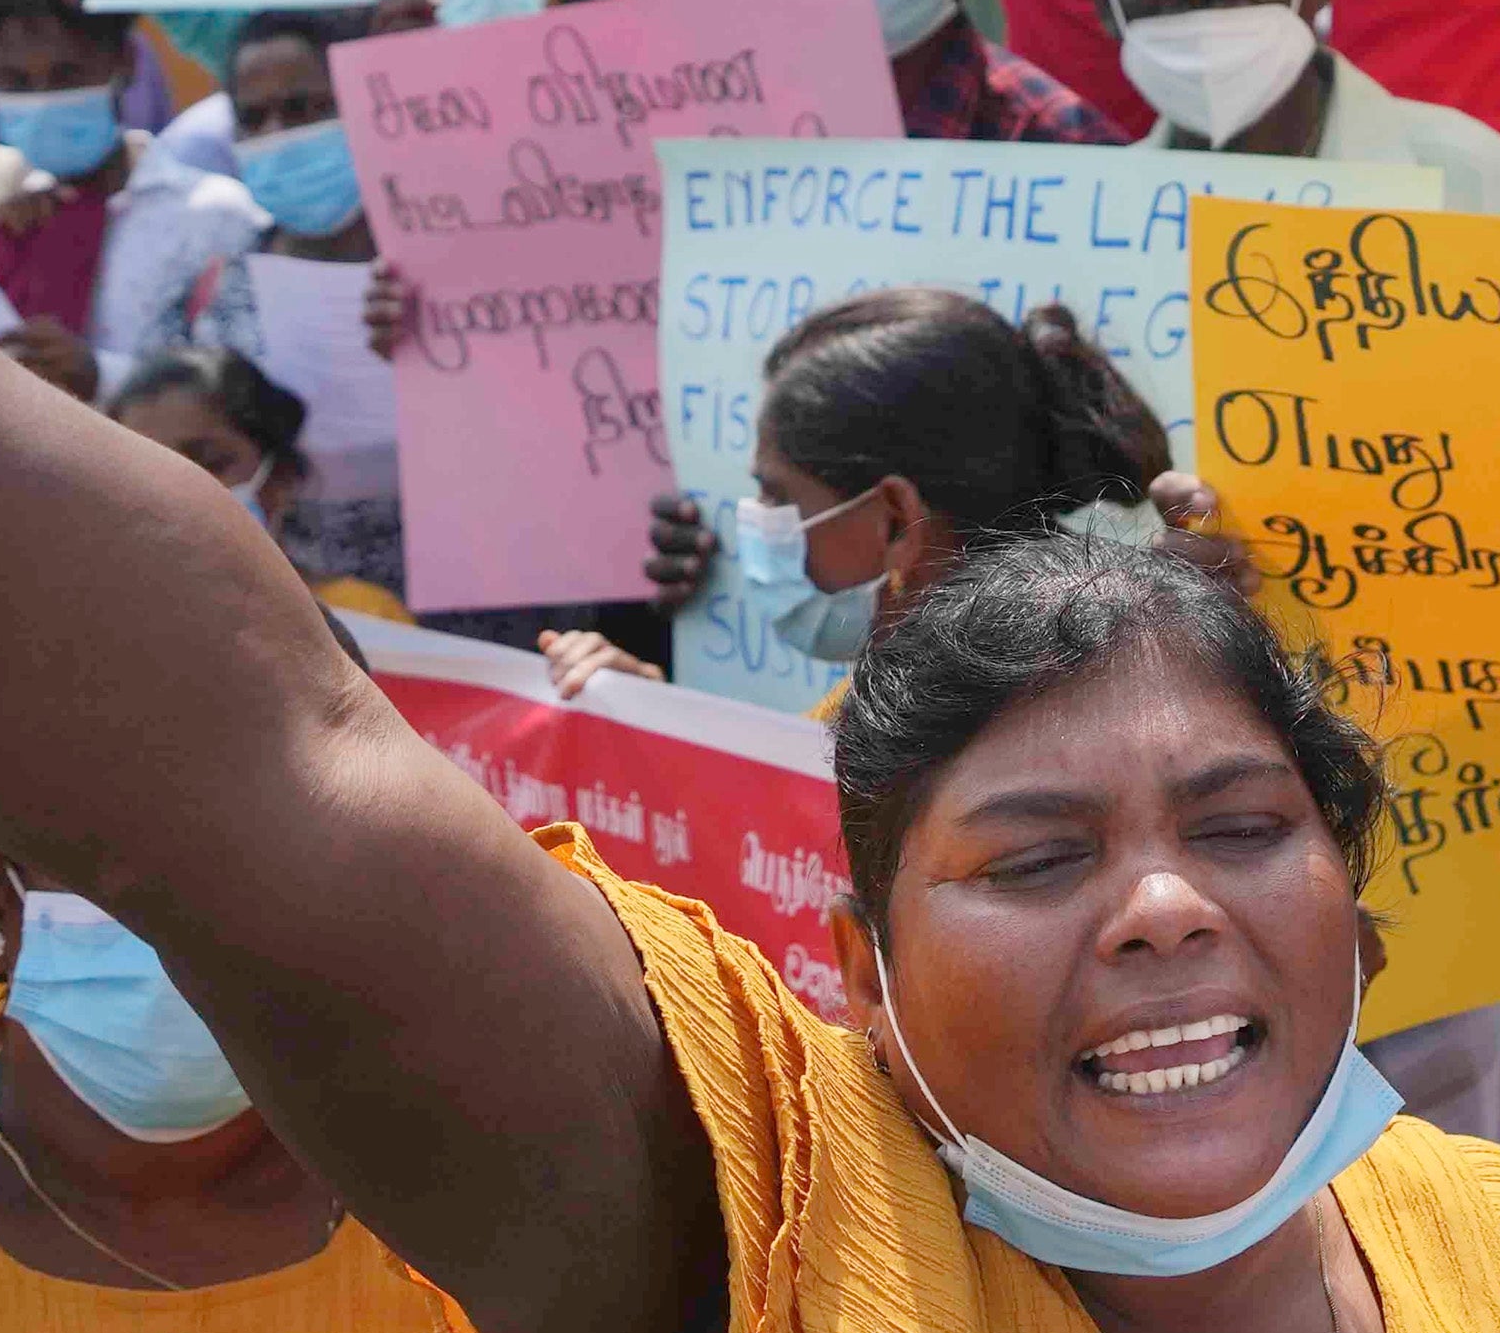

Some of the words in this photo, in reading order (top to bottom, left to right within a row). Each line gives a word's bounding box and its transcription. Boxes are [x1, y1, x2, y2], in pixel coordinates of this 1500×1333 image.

[684, 167, 923, 233] ENFORCE
[951, 167, 1066, 244] THE
[1211, 387, 1456, 511] எமது
